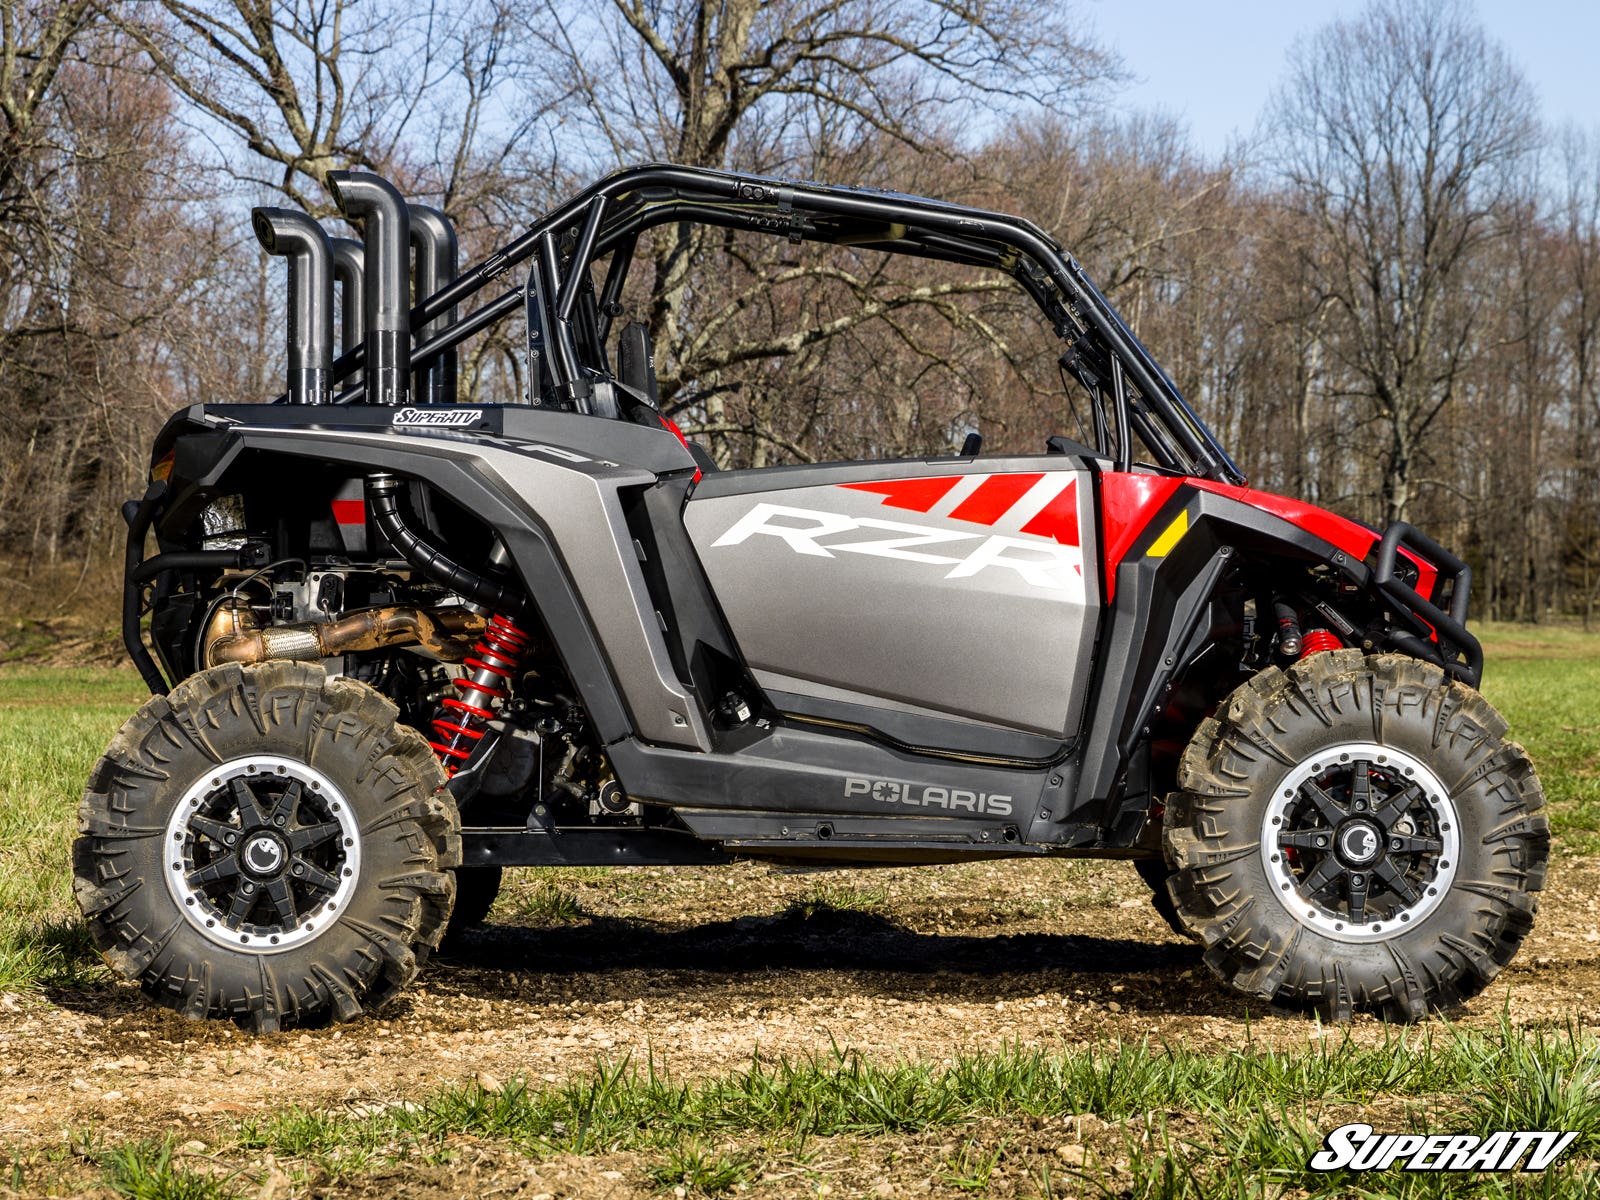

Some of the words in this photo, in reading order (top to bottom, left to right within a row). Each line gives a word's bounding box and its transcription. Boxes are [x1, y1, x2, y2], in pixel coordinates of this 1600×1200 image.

[395, 408, 480, 424] SUPERATV
[710, 502, 1080, 592] RZR
[844, 777, 1013, 816] POLARIS
